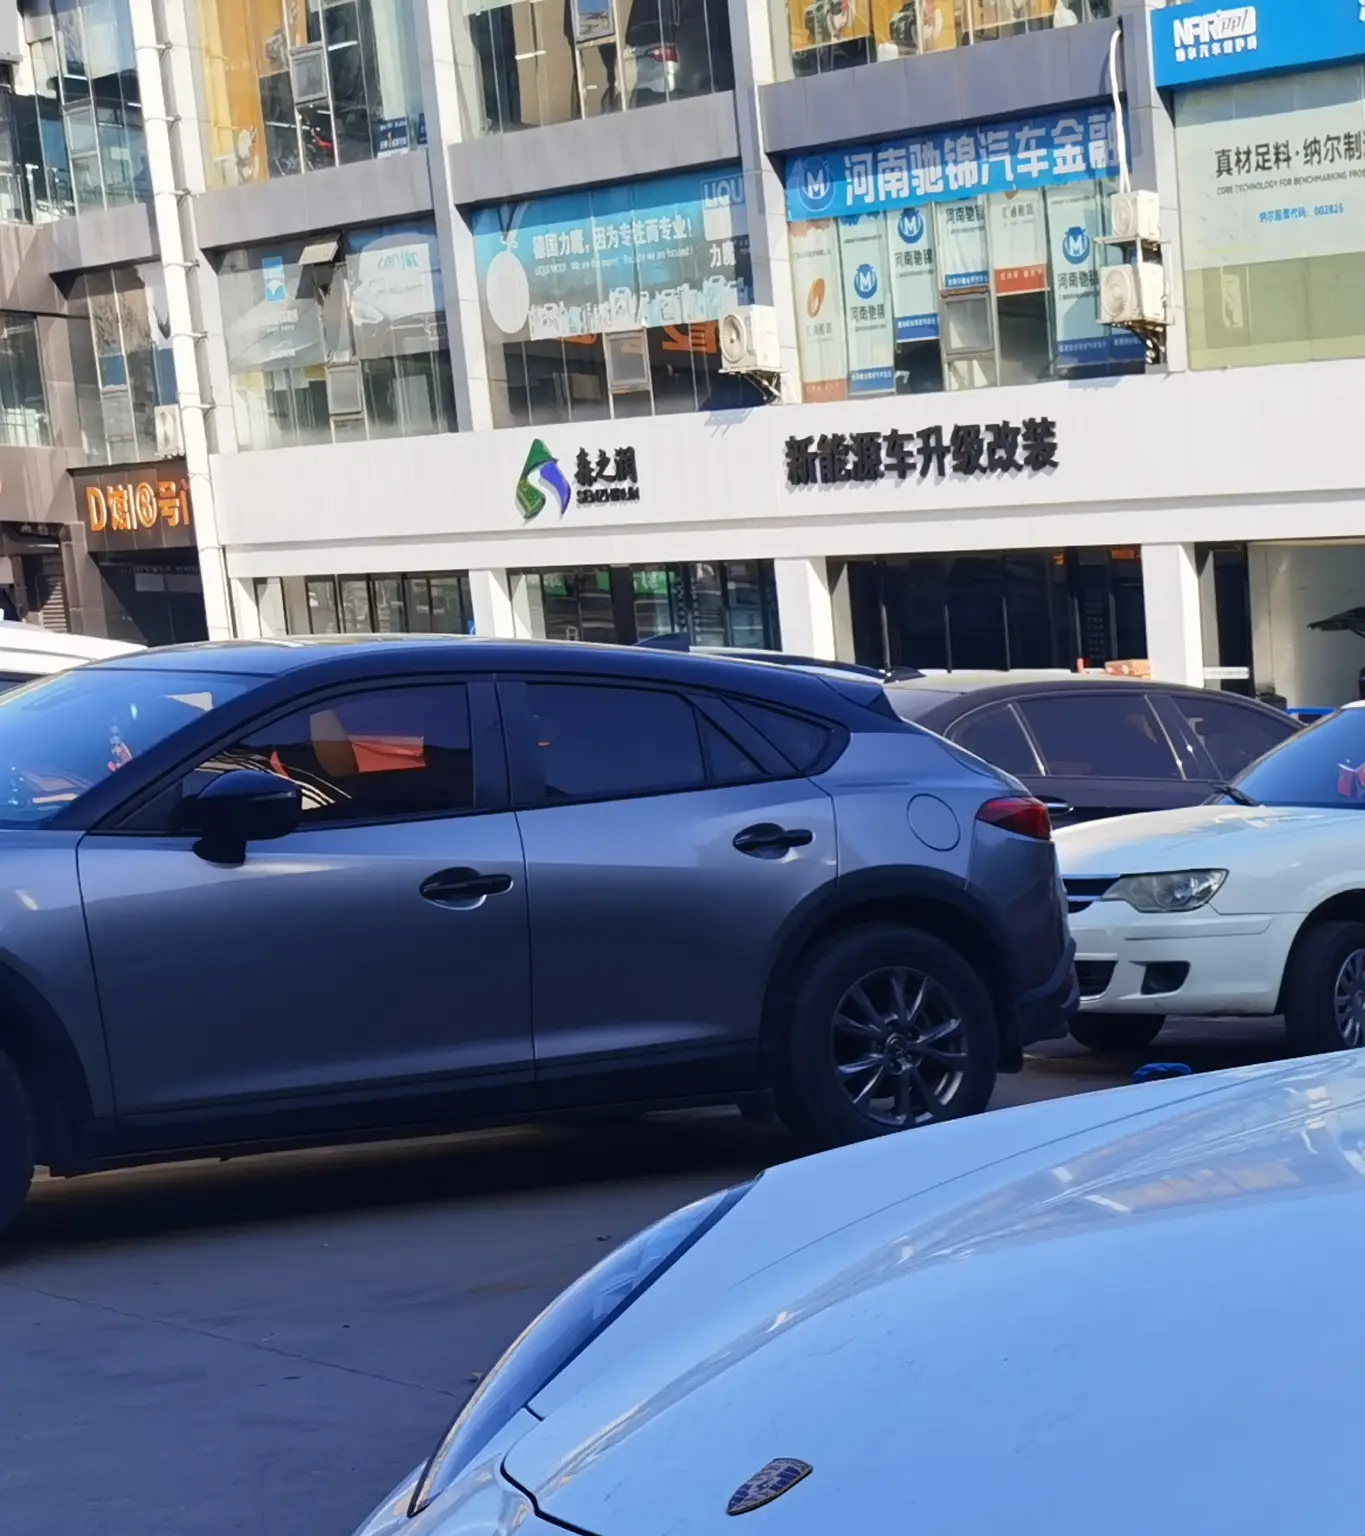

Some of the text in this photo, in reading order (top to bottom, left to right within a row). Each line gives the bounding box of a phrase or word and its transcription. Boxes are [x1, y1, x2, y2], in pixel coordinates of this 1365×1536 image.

[844, 113, 1117, 206] 河南驰锦汽车金融
[784, 416, 1059, 486] 新能源车升级改装
